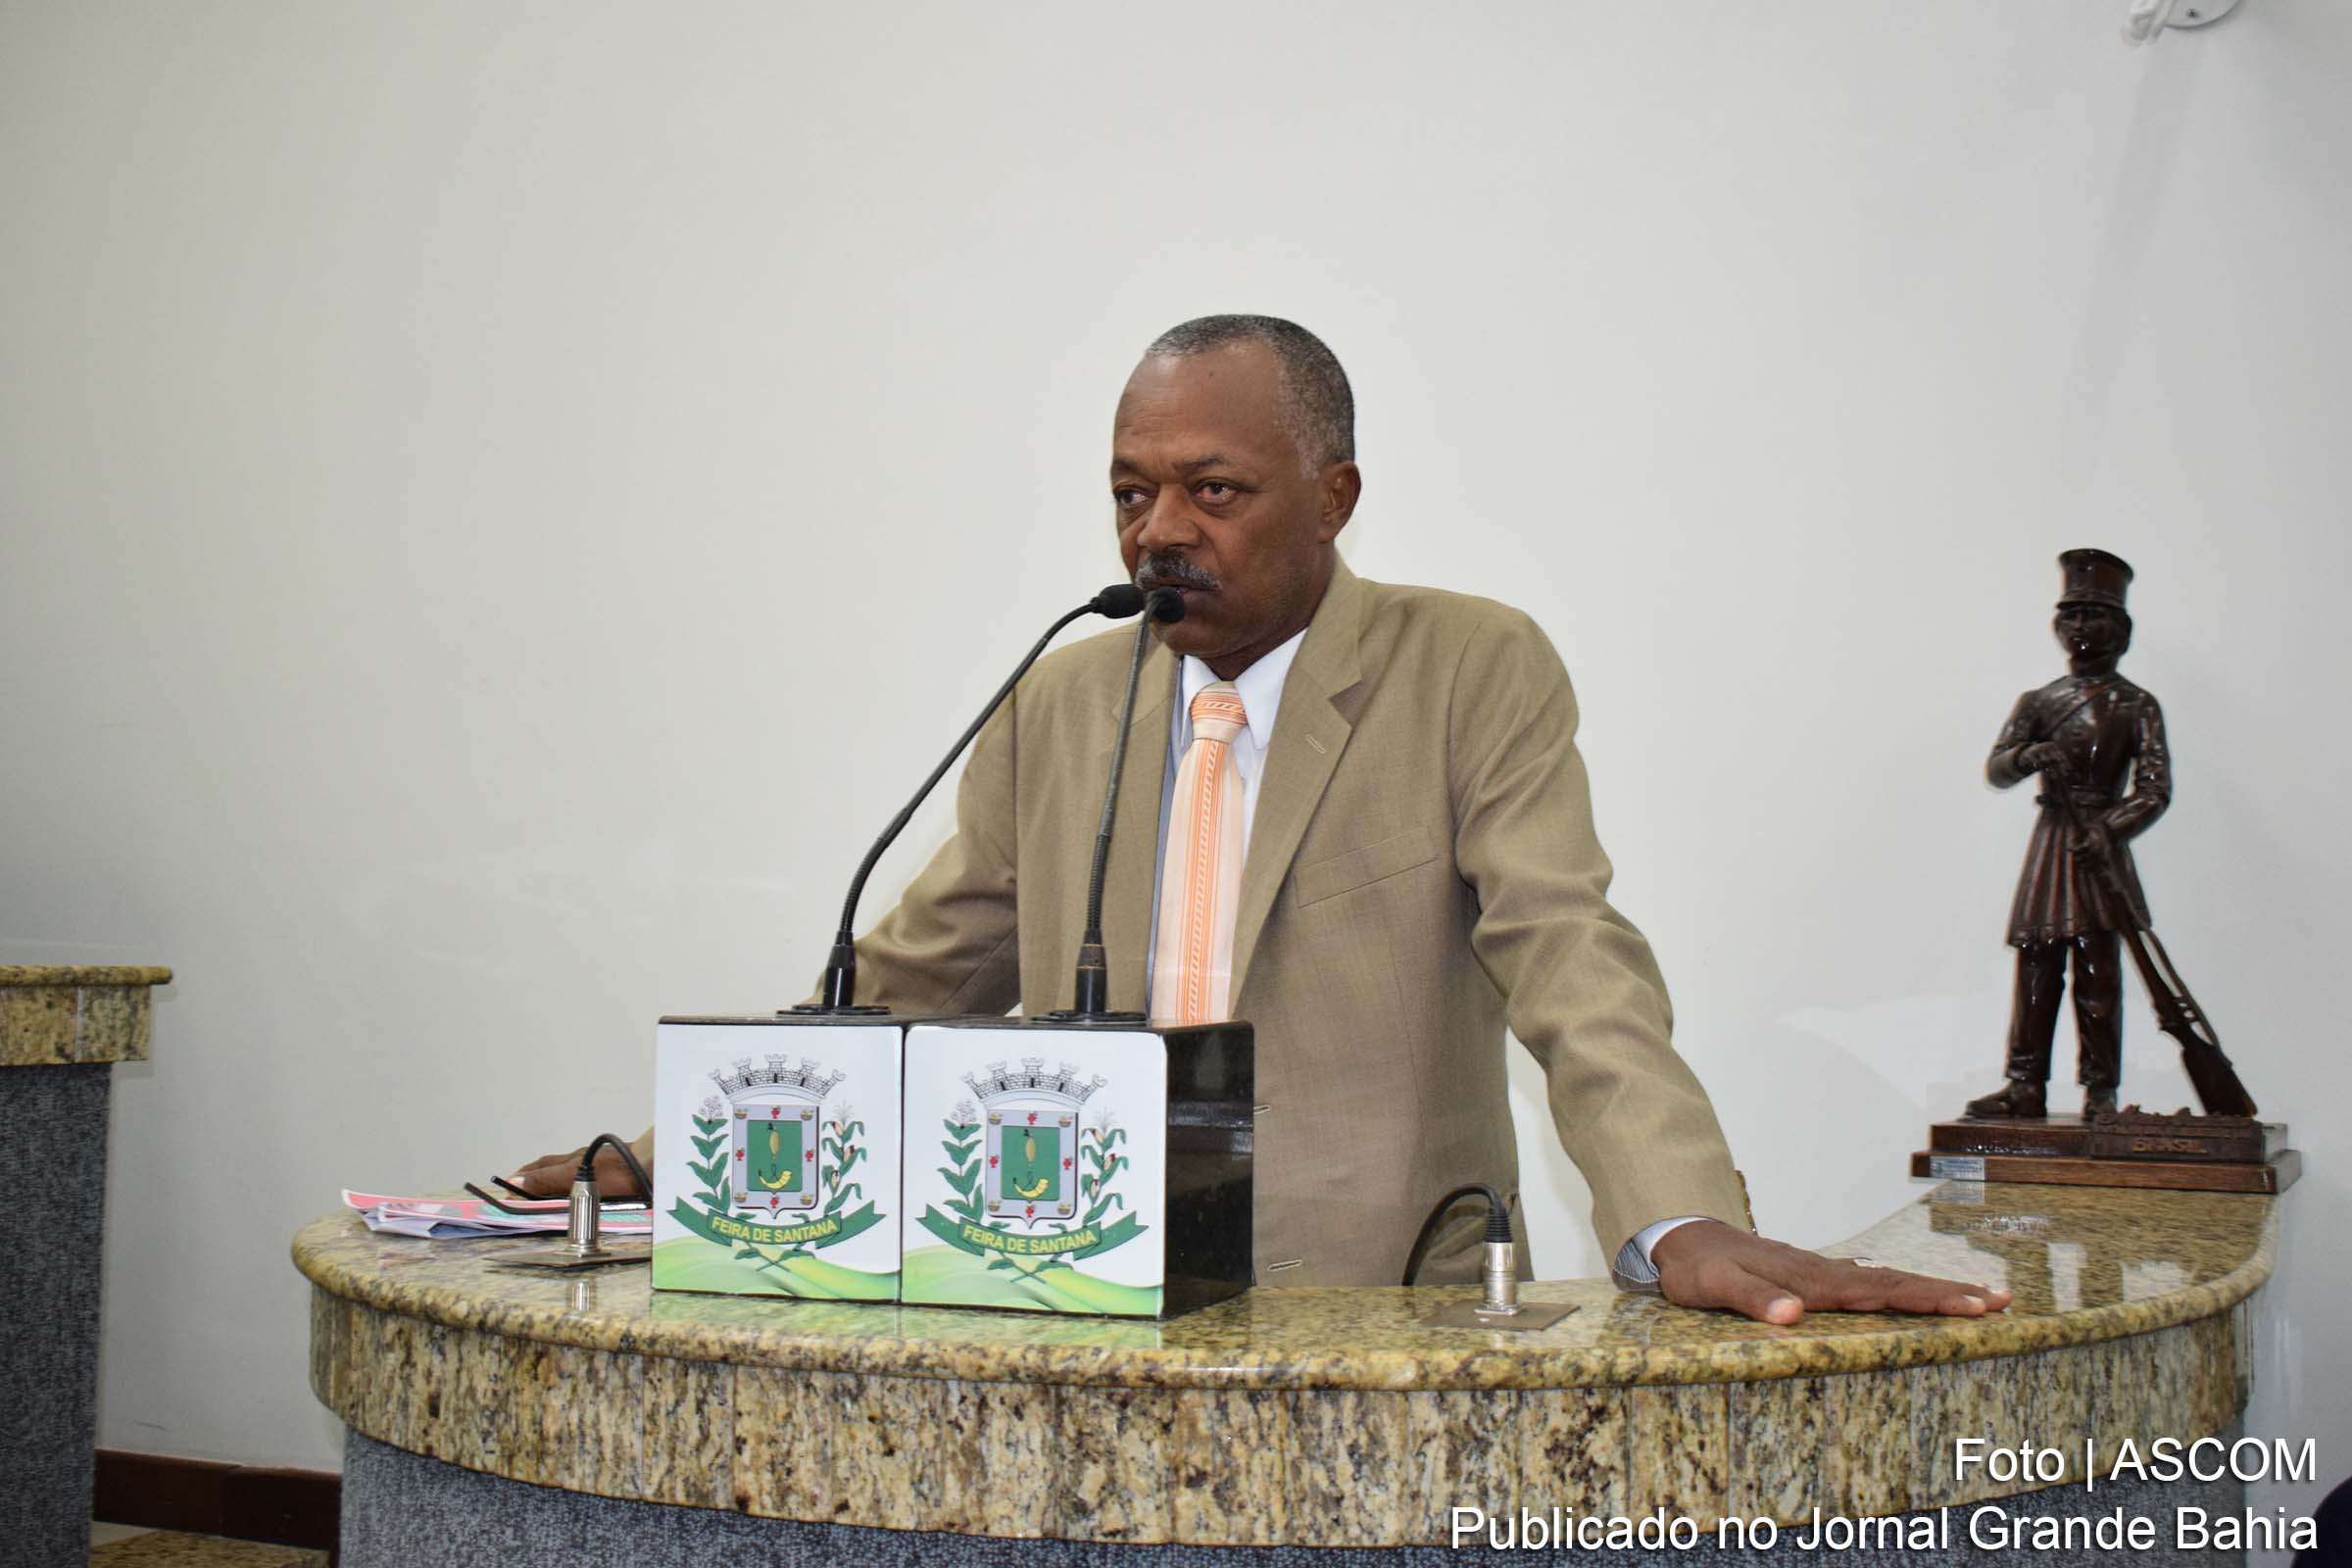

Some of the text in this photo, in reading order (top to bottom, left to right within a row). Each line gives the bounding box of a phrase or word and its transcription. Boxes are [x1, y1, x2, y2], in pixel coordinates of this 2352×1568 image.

[711, 1216, 838, 1243] FEIRA DE SANTANA
[963, 1224, 1098, 1253] FEIRA DE SANTANA
